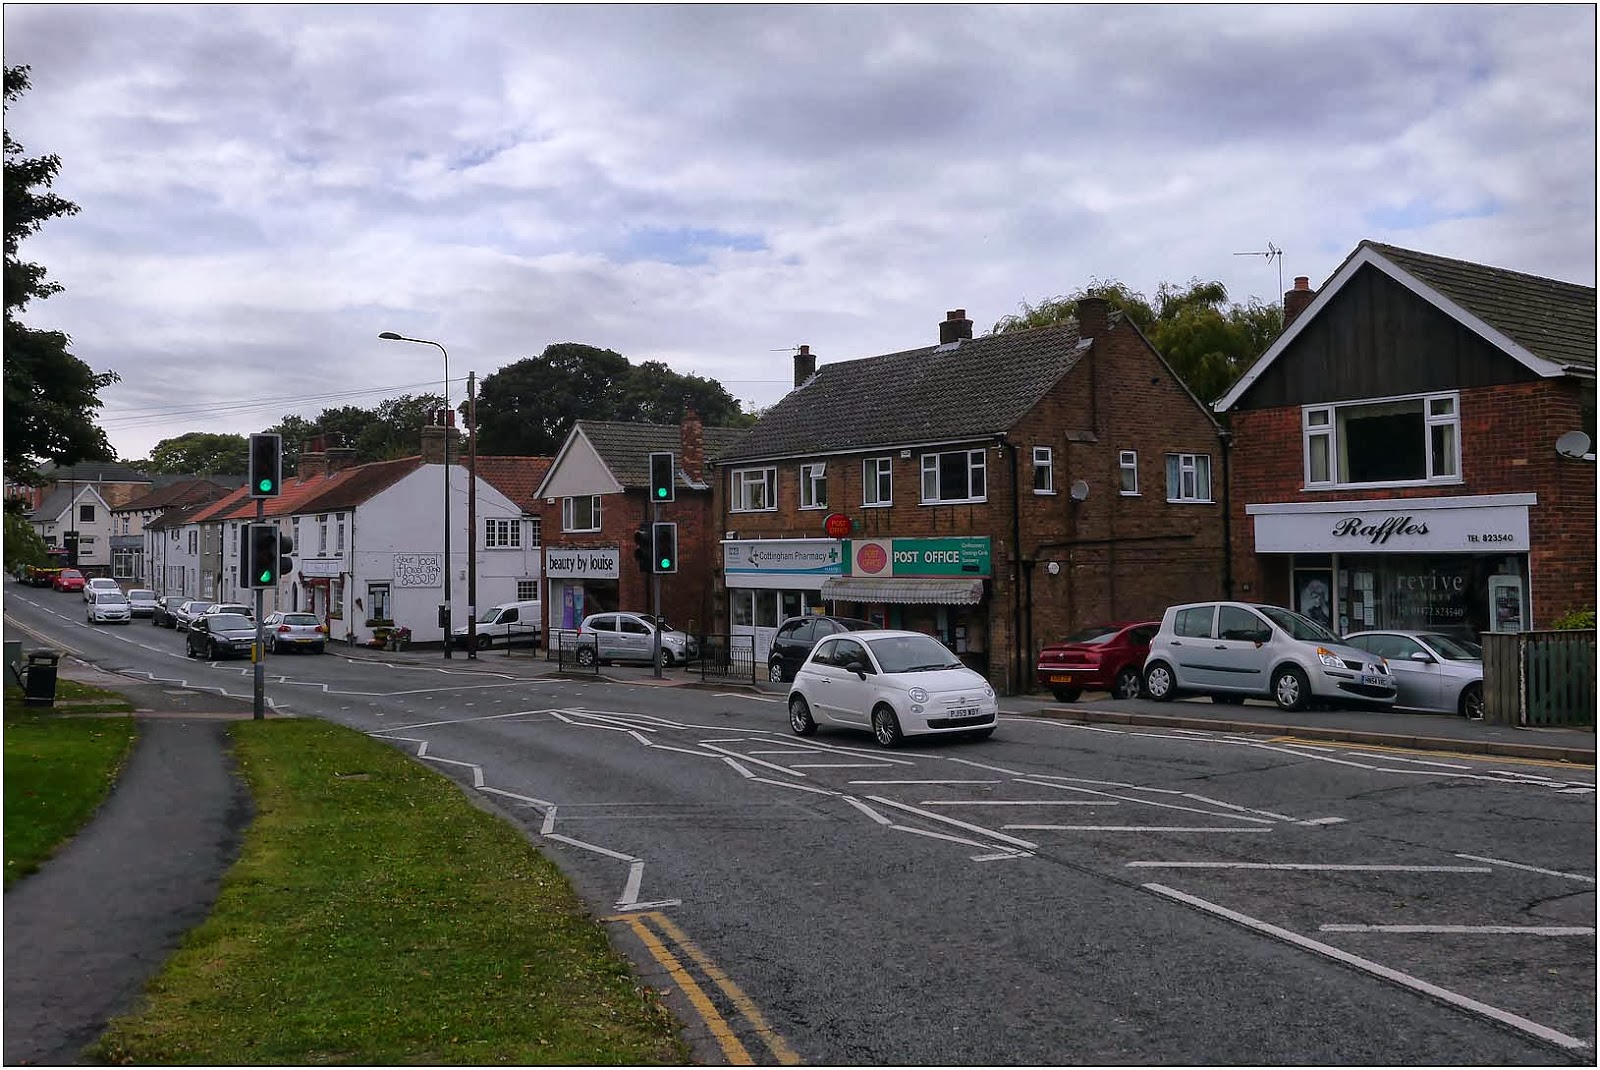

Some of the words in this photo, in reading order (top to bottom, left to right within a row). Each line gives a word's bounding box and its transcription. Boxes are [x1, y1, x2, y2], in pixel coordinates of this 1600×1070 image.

[1332, 516, 1429, 544] Raffles
[1482, 533, 1514, 543] 823540
[417, 554, 438, 566] local
[759, 551, 793, 562] Cottingham
[795, 551, 827, 563] Pharmacy
[864, 550, 880, 559] POST
[894, 551, 919, 563] POST
[924, 550, 960, 563] OFFICE
[549, 554, 575, 573] beauty
[577, 554, 587, 573] by
[590, 554, 614, 570] louise
[402, 573, 436, 586] 823219
[1397, 569, 1463, 591] revive
[950, 709, 967, 718] PJ59
